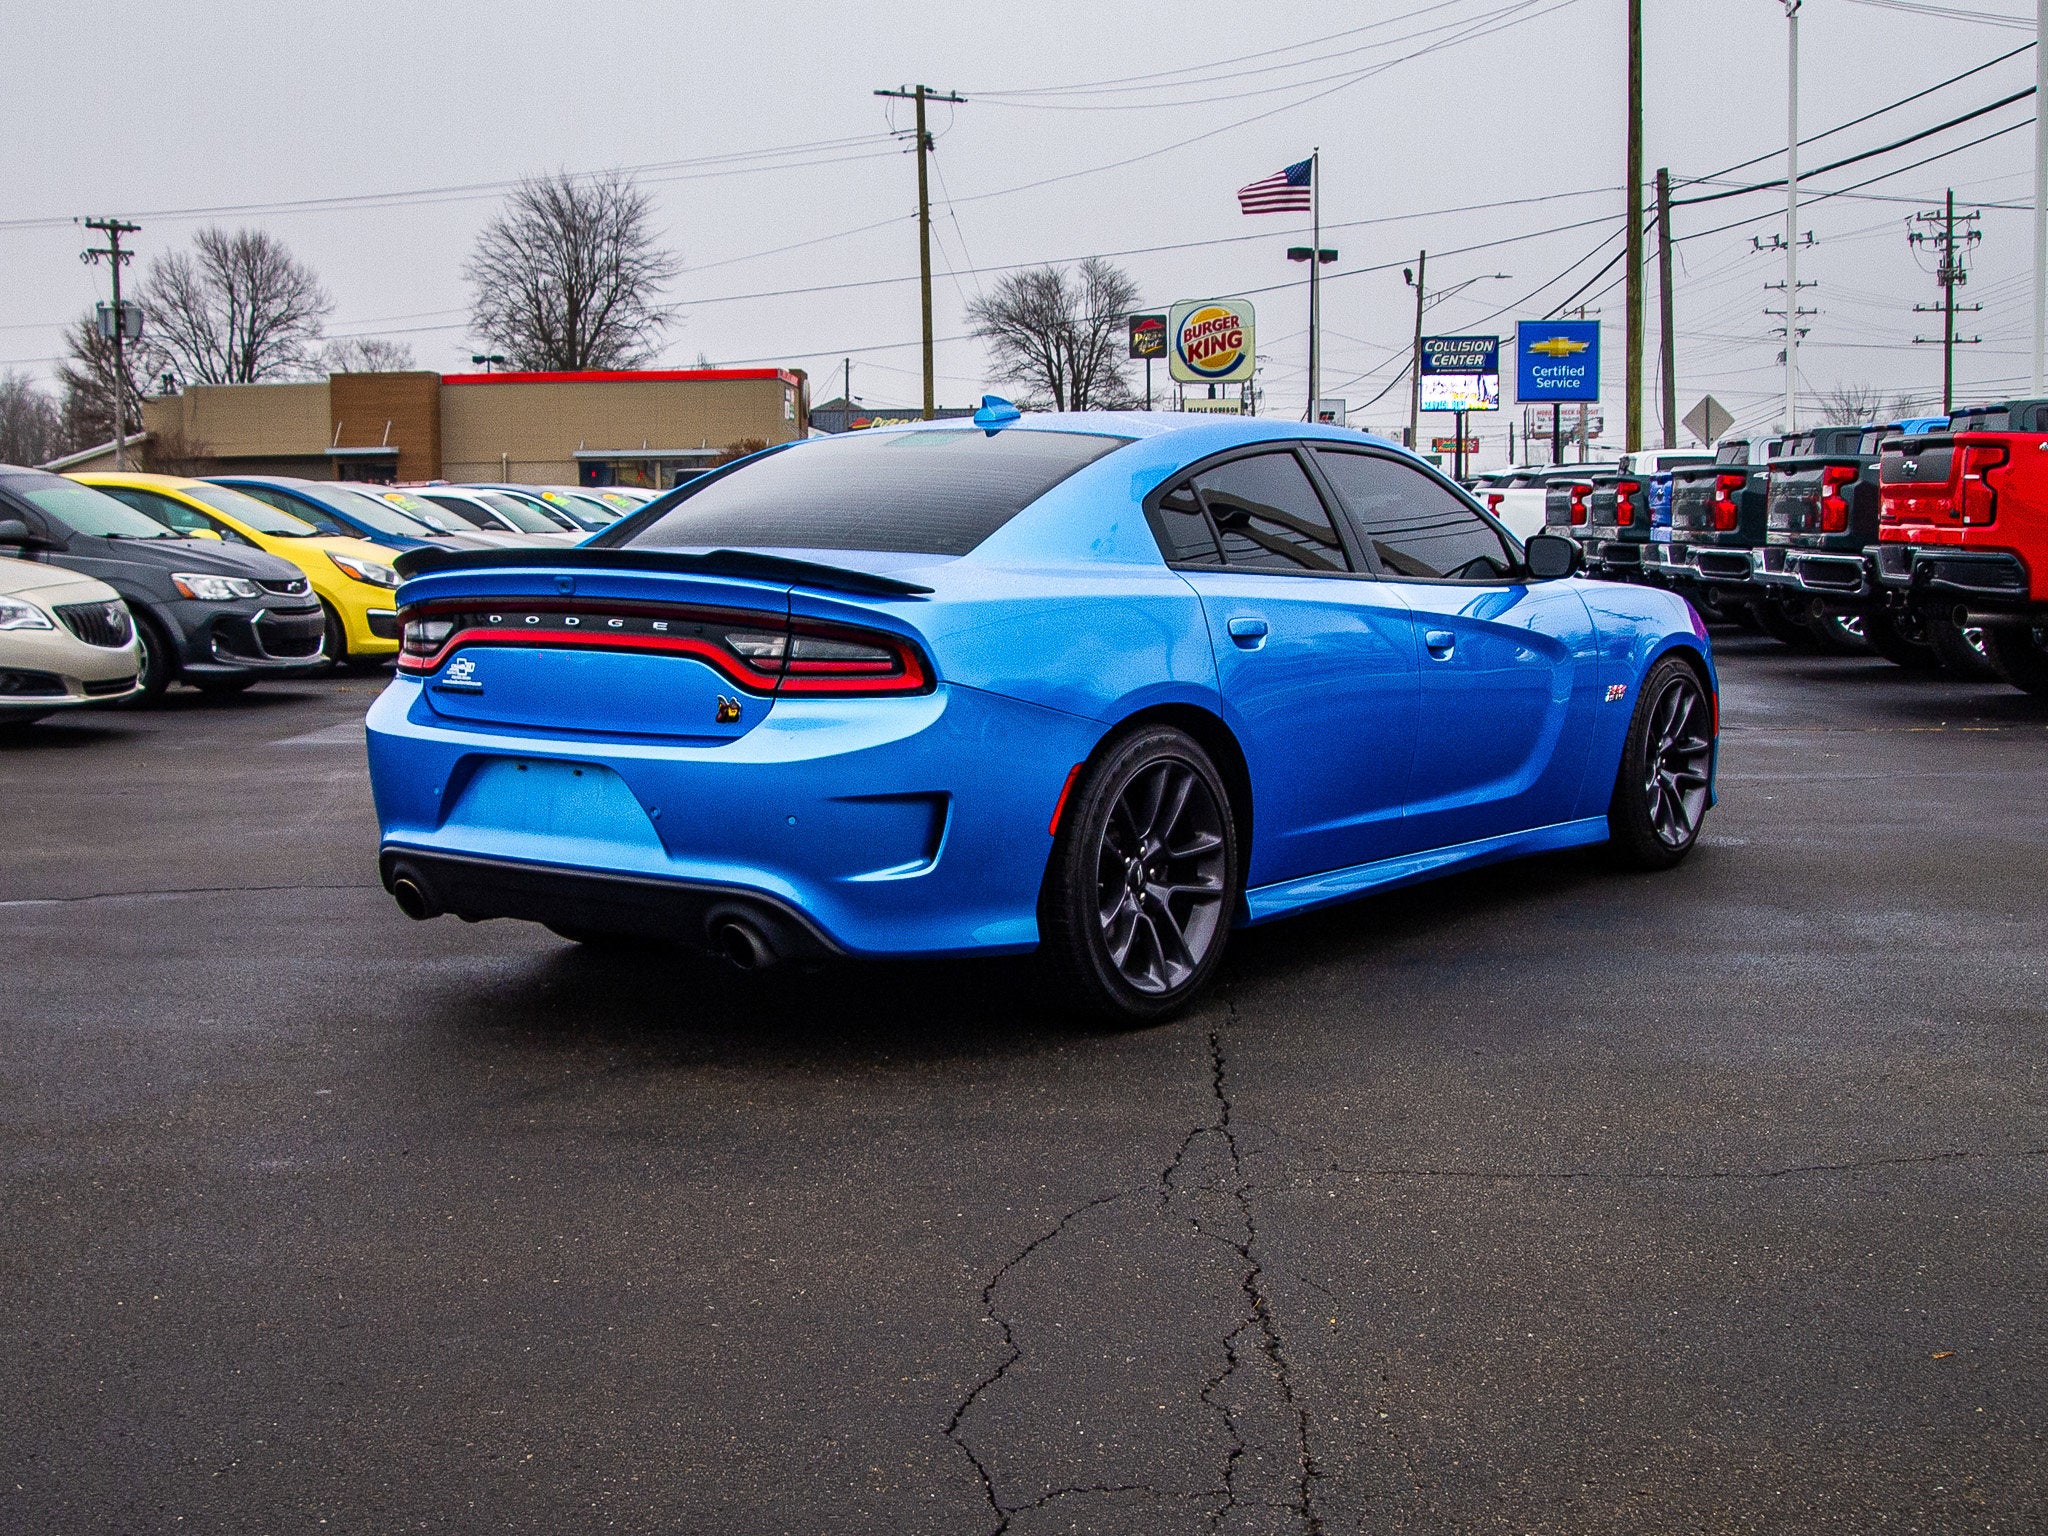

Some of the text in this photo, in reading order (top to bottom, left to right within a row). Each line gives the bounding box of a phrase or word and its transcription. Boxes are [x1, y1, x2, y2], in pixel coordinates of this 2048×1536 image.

[1183, 315, 1240, 343] BURGER
[1187, 330, 1243, 363] KING
[1424, 340, 1494, 352] COLLISION
[1431, 353, 1484, 366] CENTER
[1532, 365, 1585, 377] Certified
[1536, 377, 1580, 388] Service
[488, 614, 669, 631] DODGE
